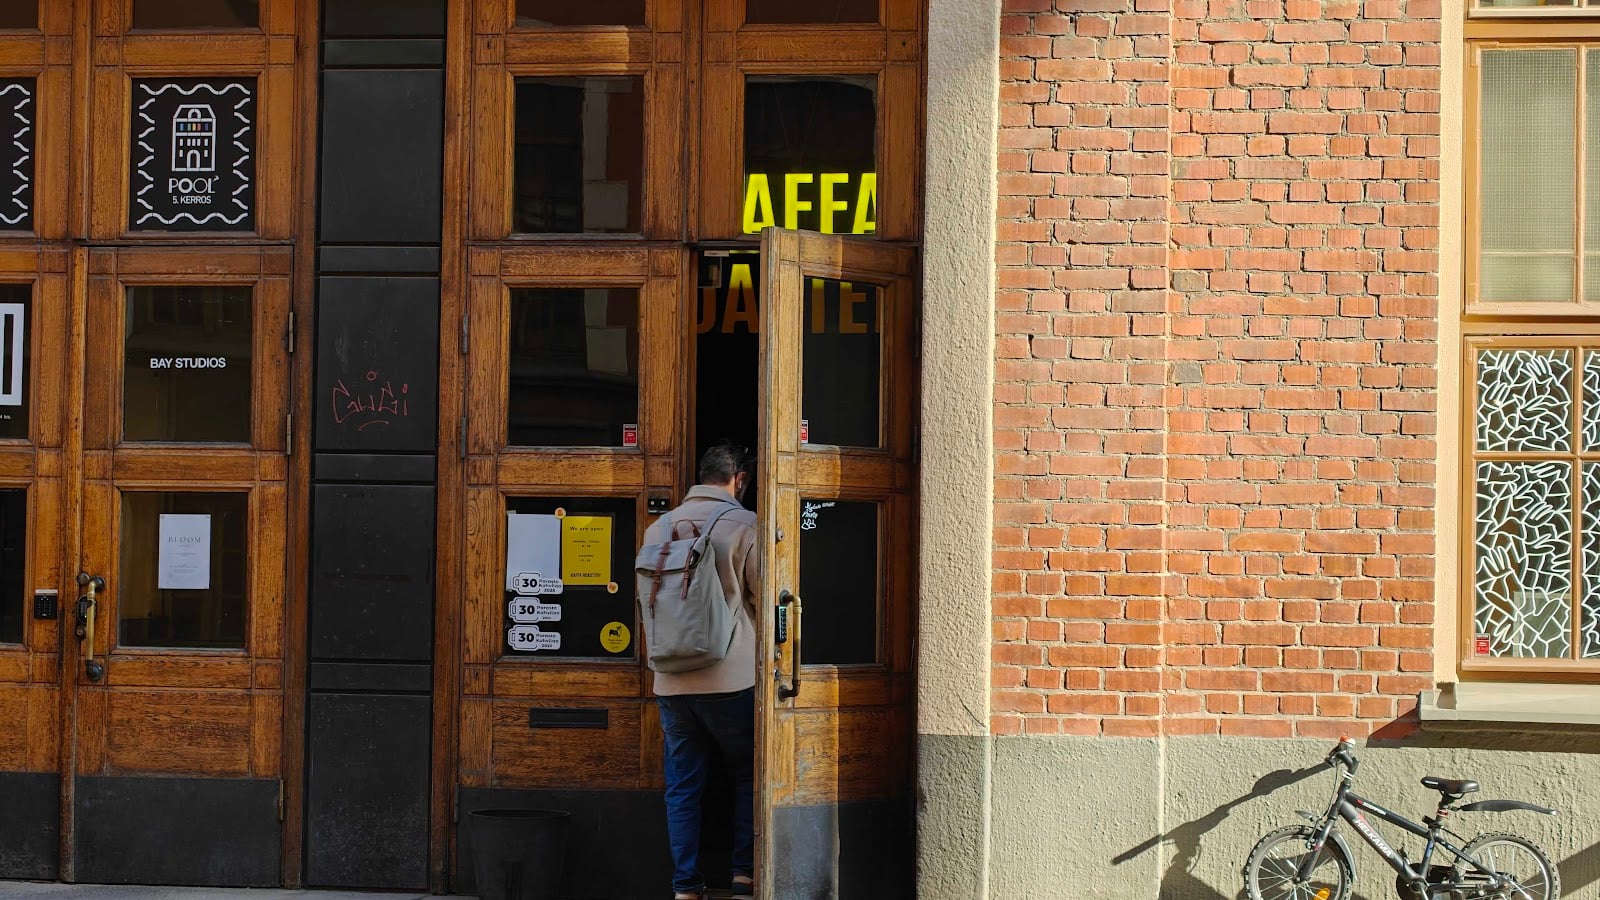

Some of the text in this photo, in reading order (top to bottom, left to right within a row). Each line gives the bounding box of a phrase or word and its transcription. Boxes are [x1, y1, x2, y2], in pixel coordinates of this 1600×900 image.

[172, 195, 212, 204] 5. KERROS
[150, 357, 226, 369] BAY STUDIOS
[522, 578, 537, 588] 30
[519, 605, 535, 615] 30
[518, 633, 535, 642] 30
[1354, 819, 1393, 858] HELKAMA
